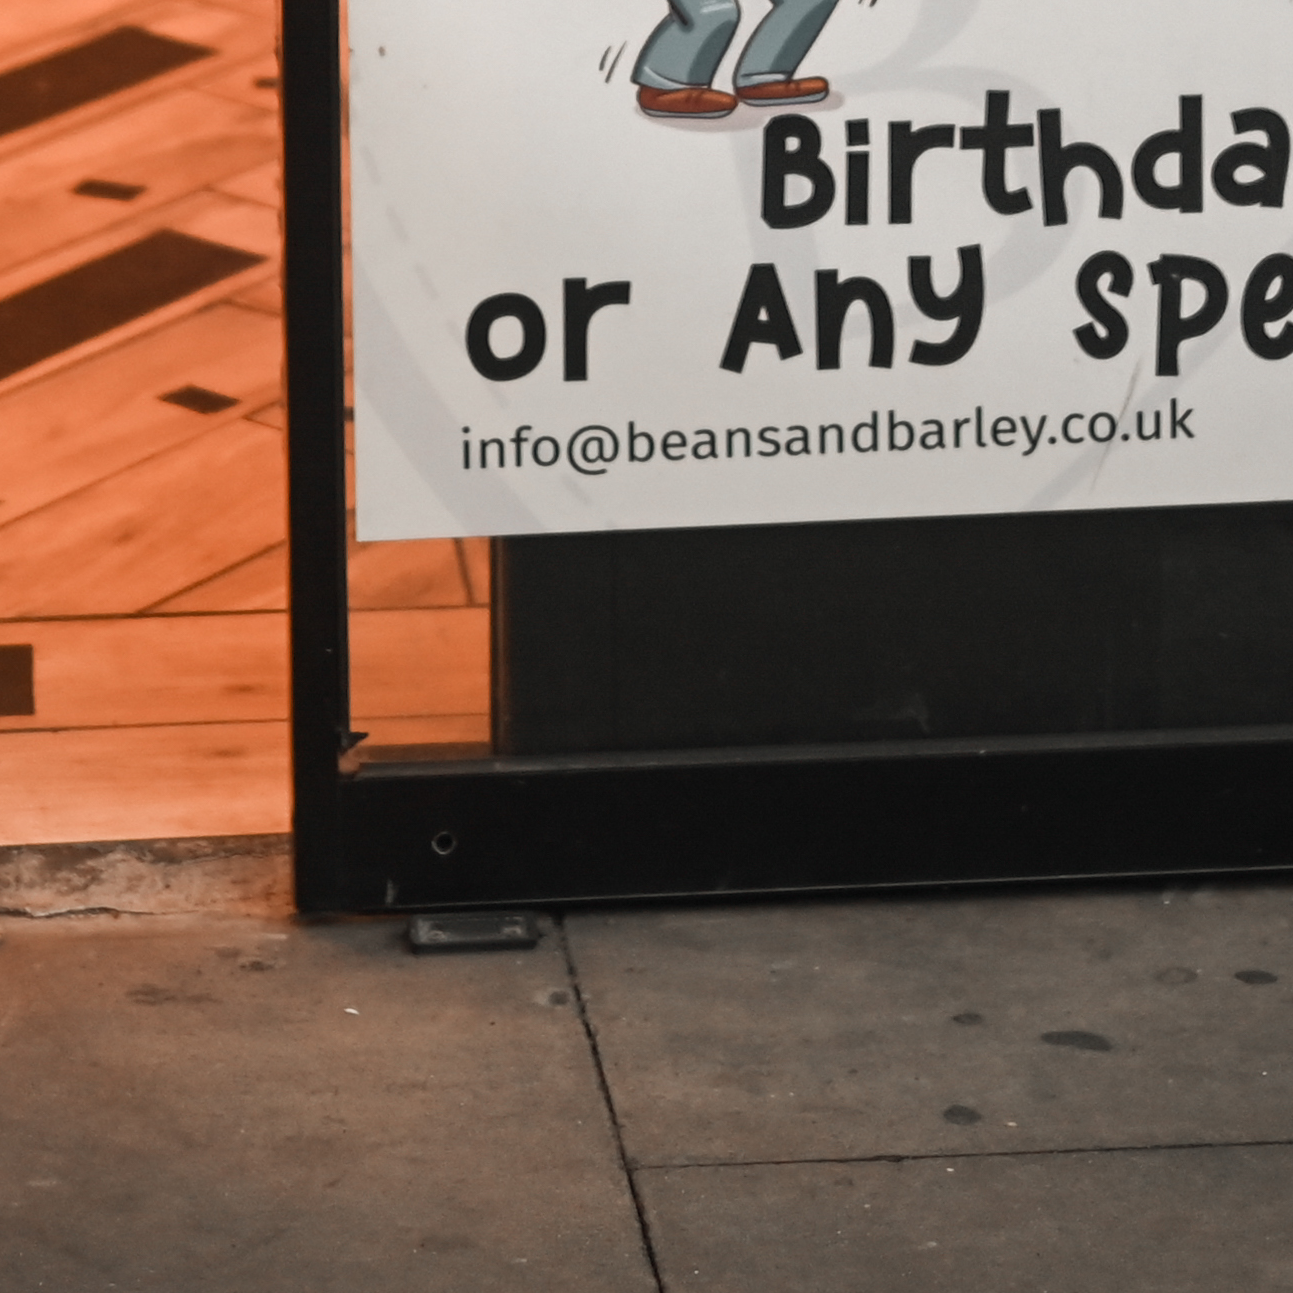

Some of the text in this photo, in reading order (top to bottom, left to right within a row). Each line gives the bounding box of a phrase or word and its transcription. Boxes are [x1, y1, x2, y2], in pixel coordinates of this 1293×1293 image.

[464, 277, 632, 383] or
[718, 243, 986, 375] Any
[461, 398, 1196, 476] info@beansandbarley.co.uk
